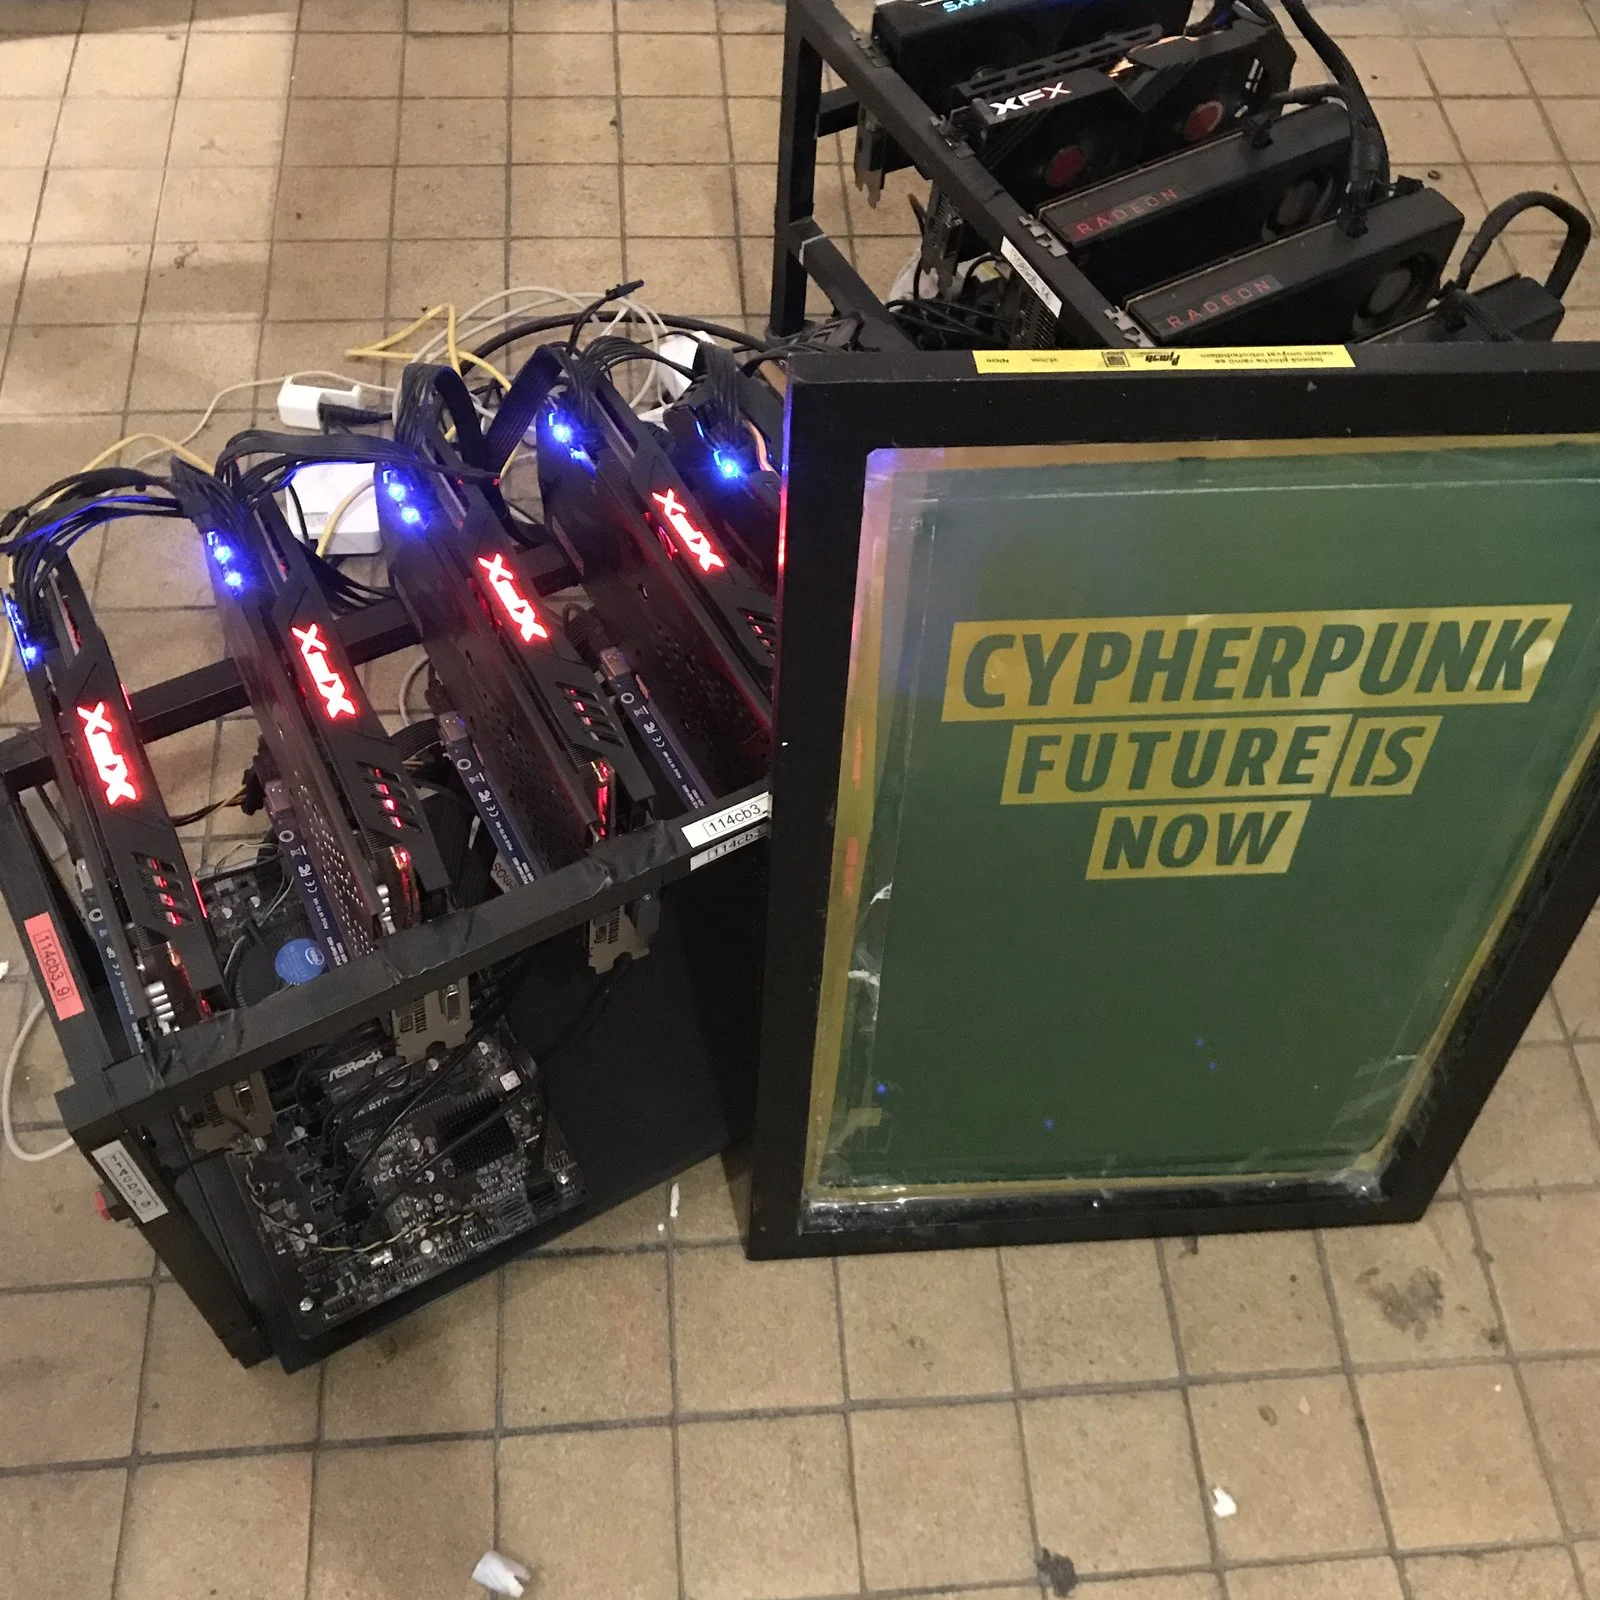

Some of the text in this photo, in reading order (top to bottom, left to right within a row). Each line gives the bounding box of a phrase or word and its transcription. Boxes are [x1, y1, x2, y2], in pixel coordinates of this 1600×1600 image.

[988, 81, 1072, 116] XFX
[1076, 188, 1178, 235] RADEON
[1166, 279, 1270, 329] RADEON
[963, 617, 1552, 709] CYPHERPUNK
[1016, 725, 1427, 794] FUTURE IS
[1101, 809, 1292, 870] NOW
[38, 935, 70, 996] 114cb3_9
